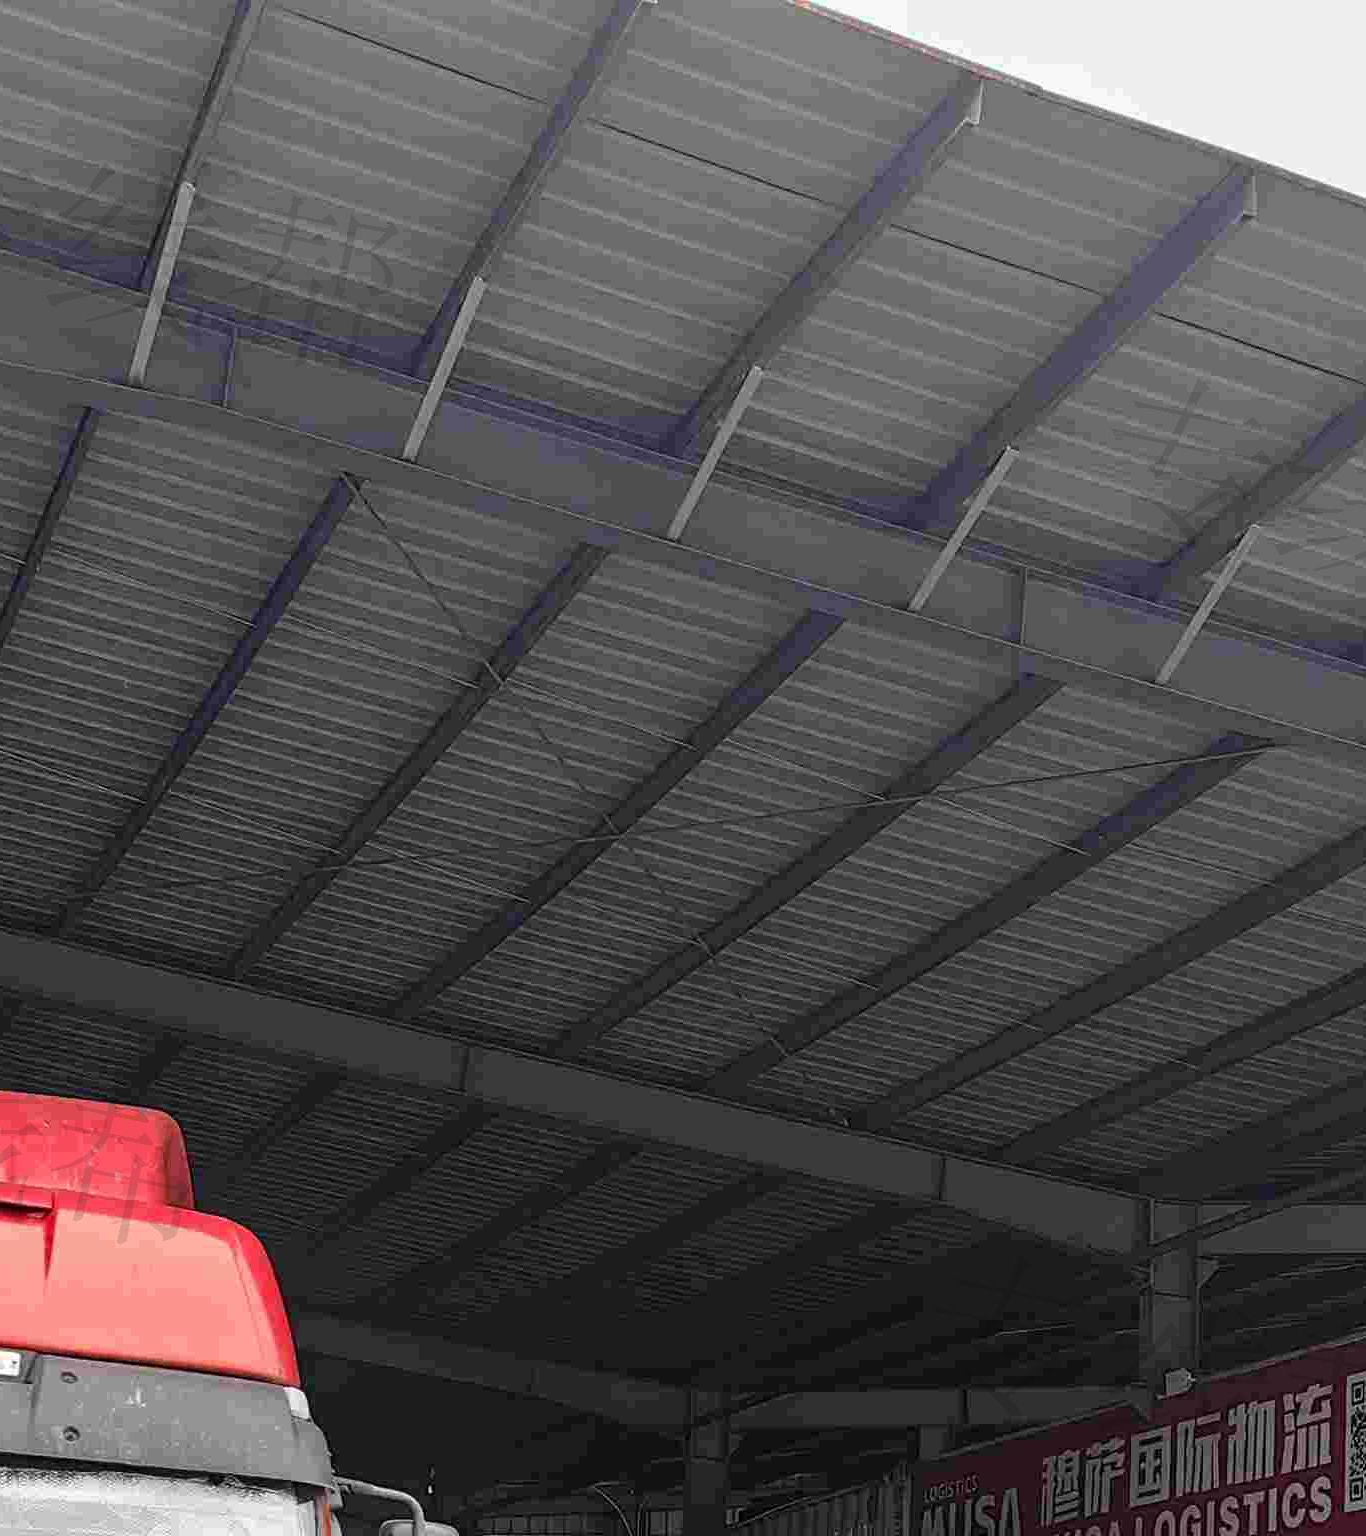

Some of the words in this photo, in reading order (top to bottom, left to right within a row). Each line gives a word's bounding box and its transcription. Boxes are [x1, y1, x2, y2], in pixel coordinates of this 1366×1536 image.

[1039, 1384, 1333, 1528] 穆萨国际物流
